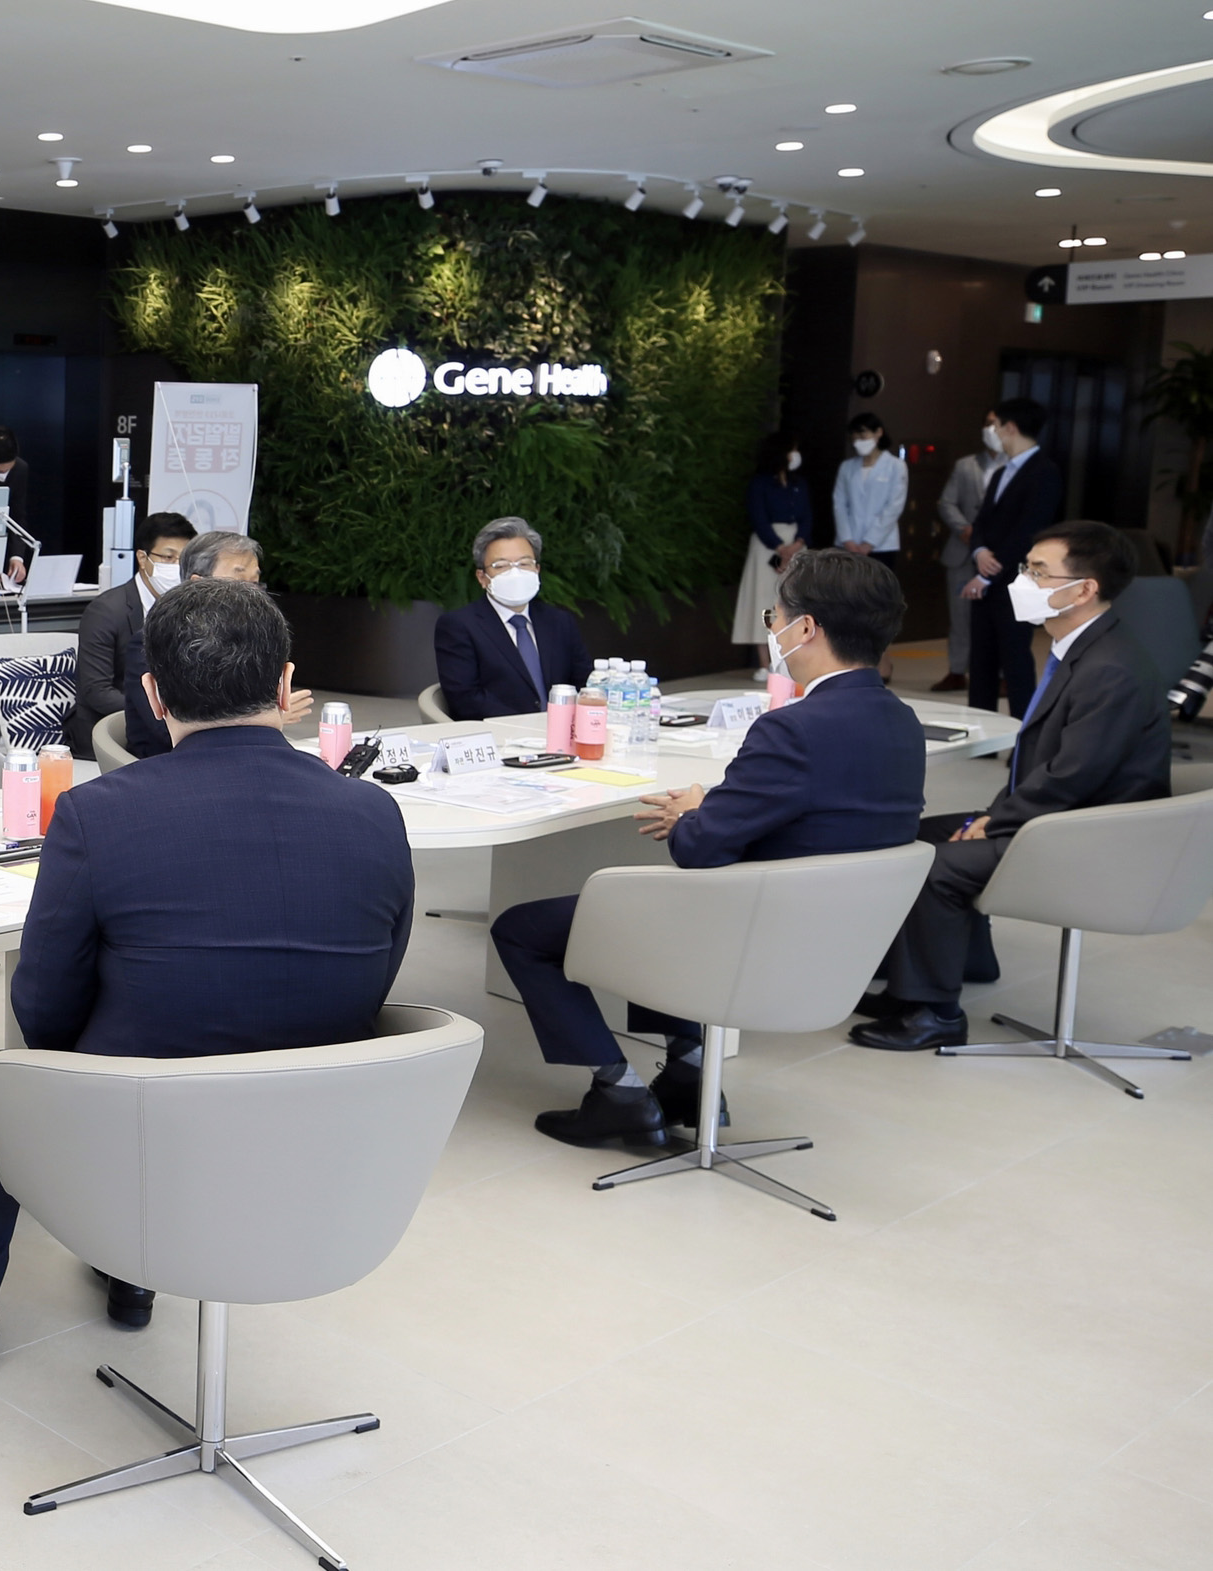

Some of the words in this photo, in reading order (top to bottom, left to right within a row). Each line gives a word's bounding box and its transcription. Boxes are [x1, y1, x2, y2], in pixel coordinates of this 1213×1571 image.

[433, 361, 533, 396] Gene
[117, 415, 137, 434] 8F
[463, 745, 496, 765] 박진규
